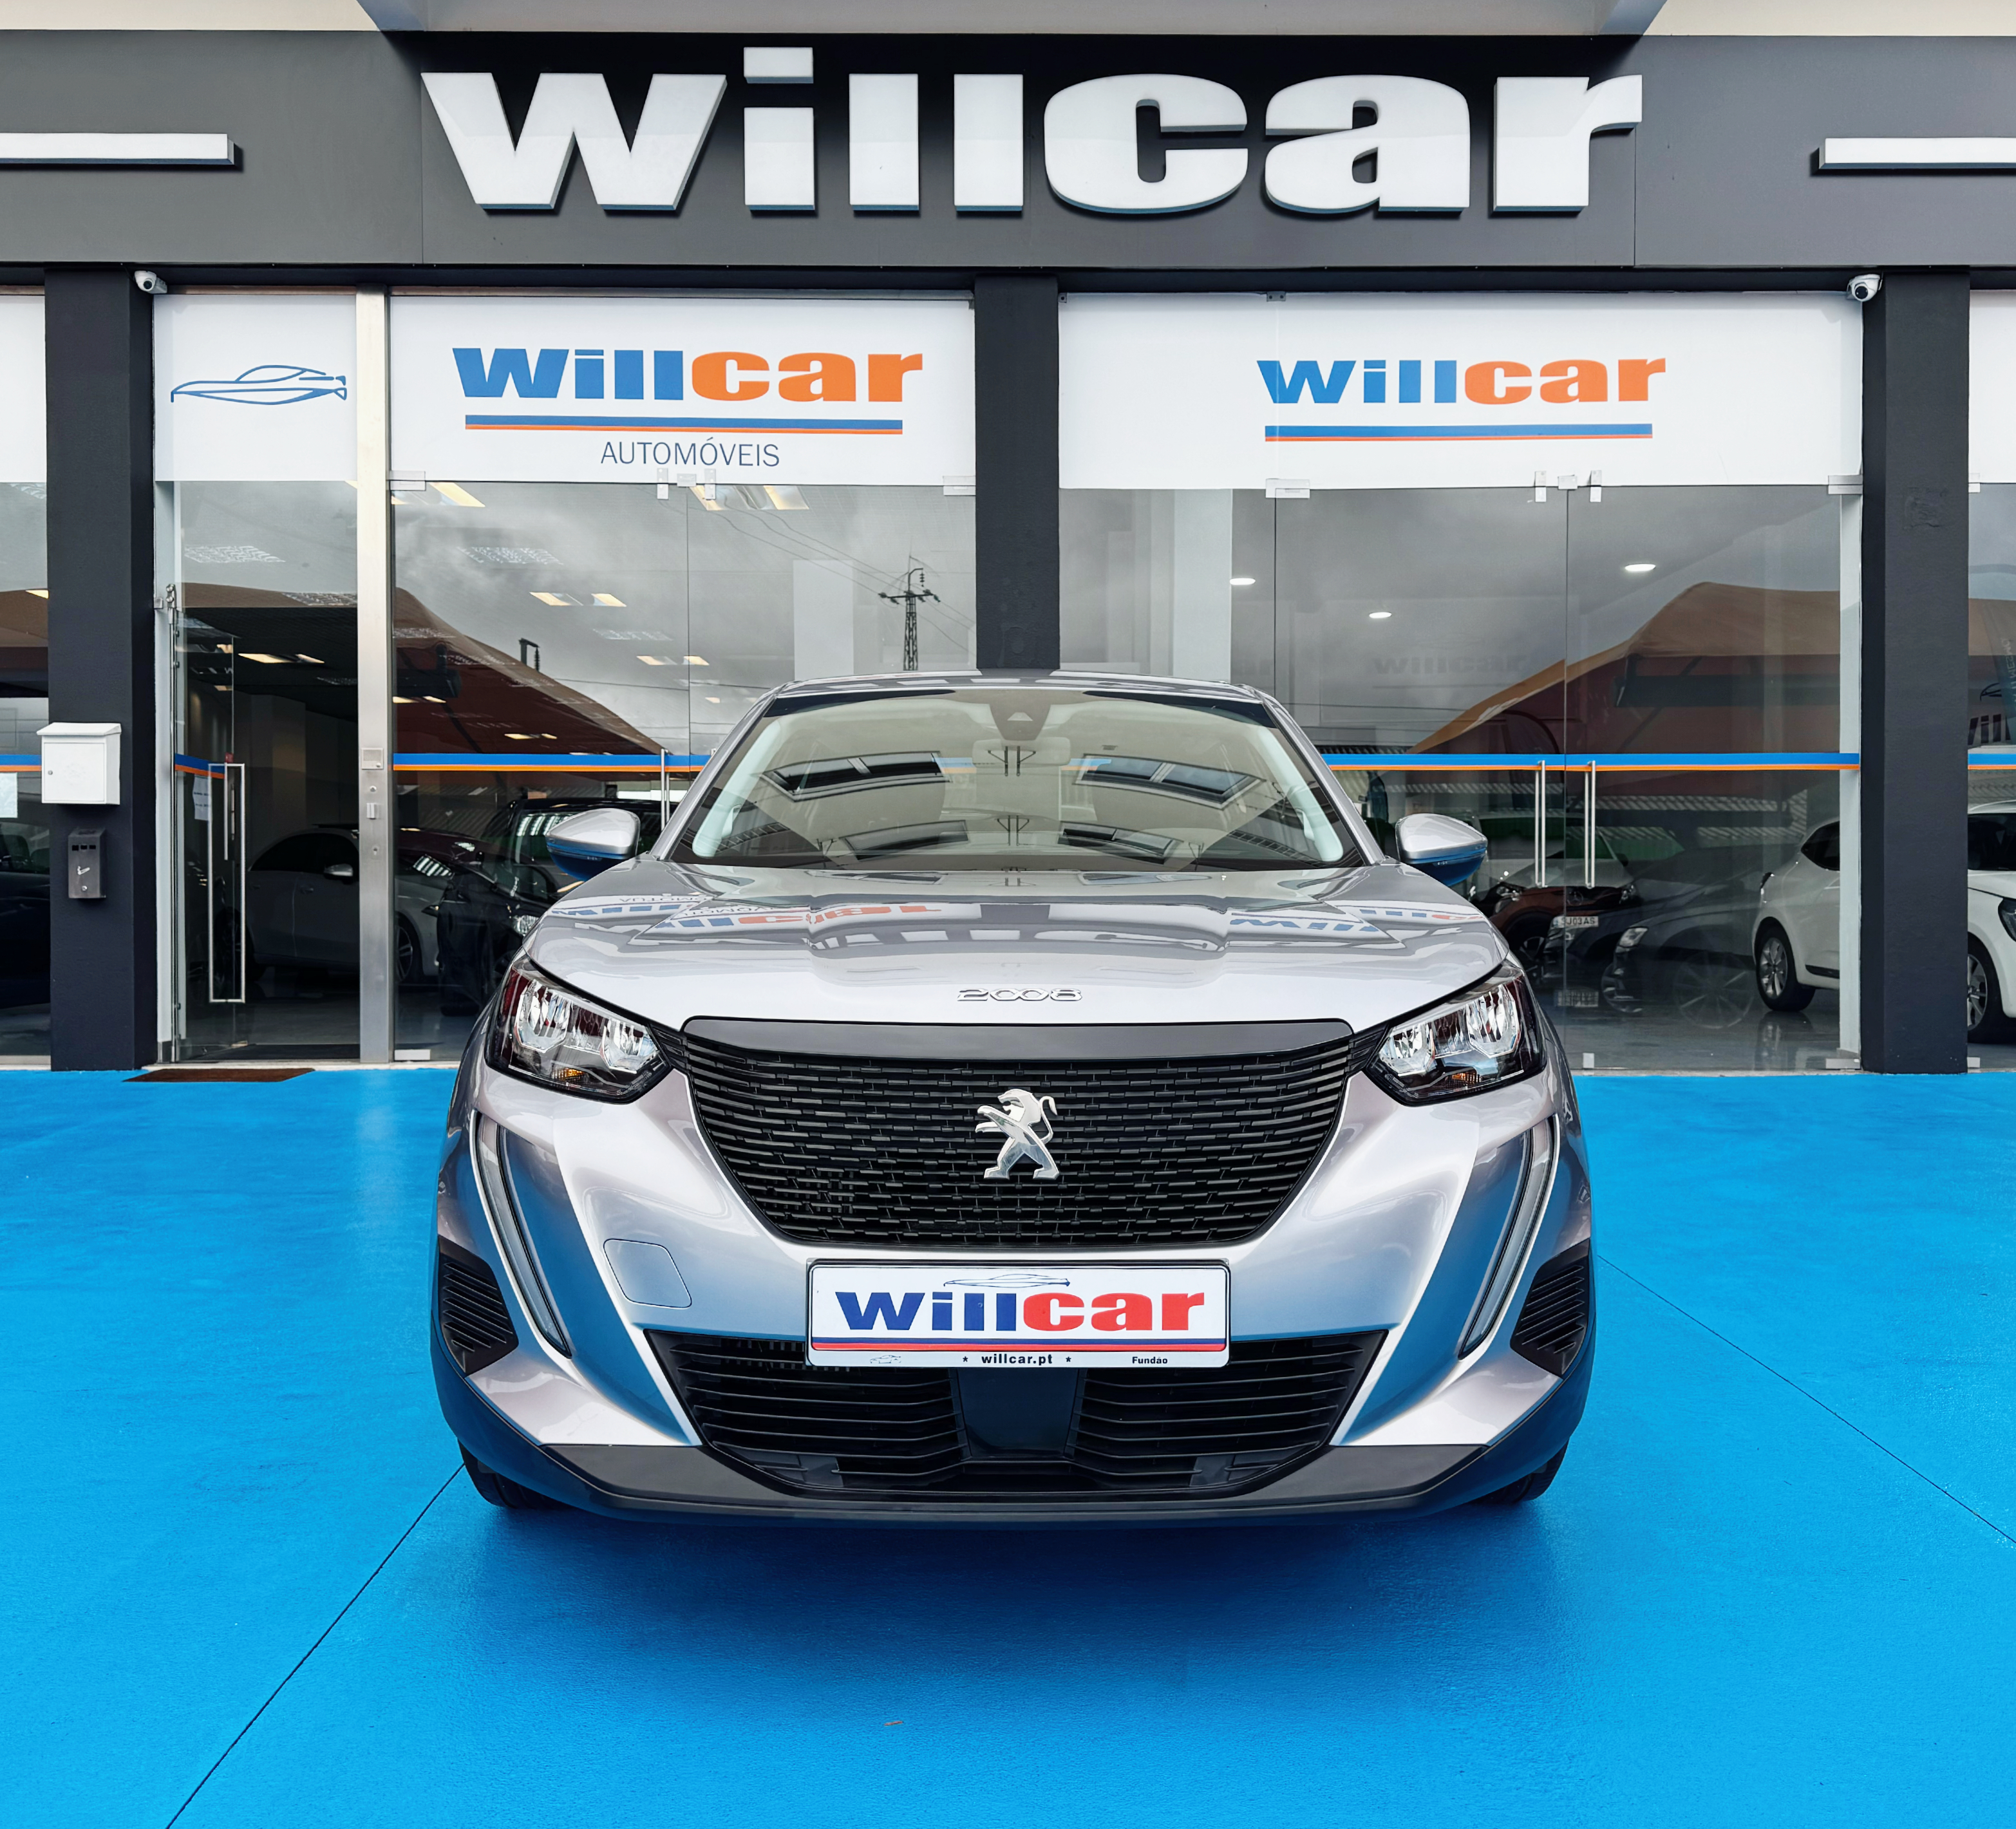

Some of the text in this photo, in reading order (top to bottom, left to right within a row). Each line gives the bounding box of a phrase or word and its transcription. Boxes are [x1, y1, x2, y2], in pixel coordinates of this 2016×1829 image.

[421, 46, 1643, 217] willcar
[601, 437, 780, 467] AUTOMÓVEIS
[957, 988, 1083, 1001] 2008
[981, 1354, 1053, 1365] willcar.pt
